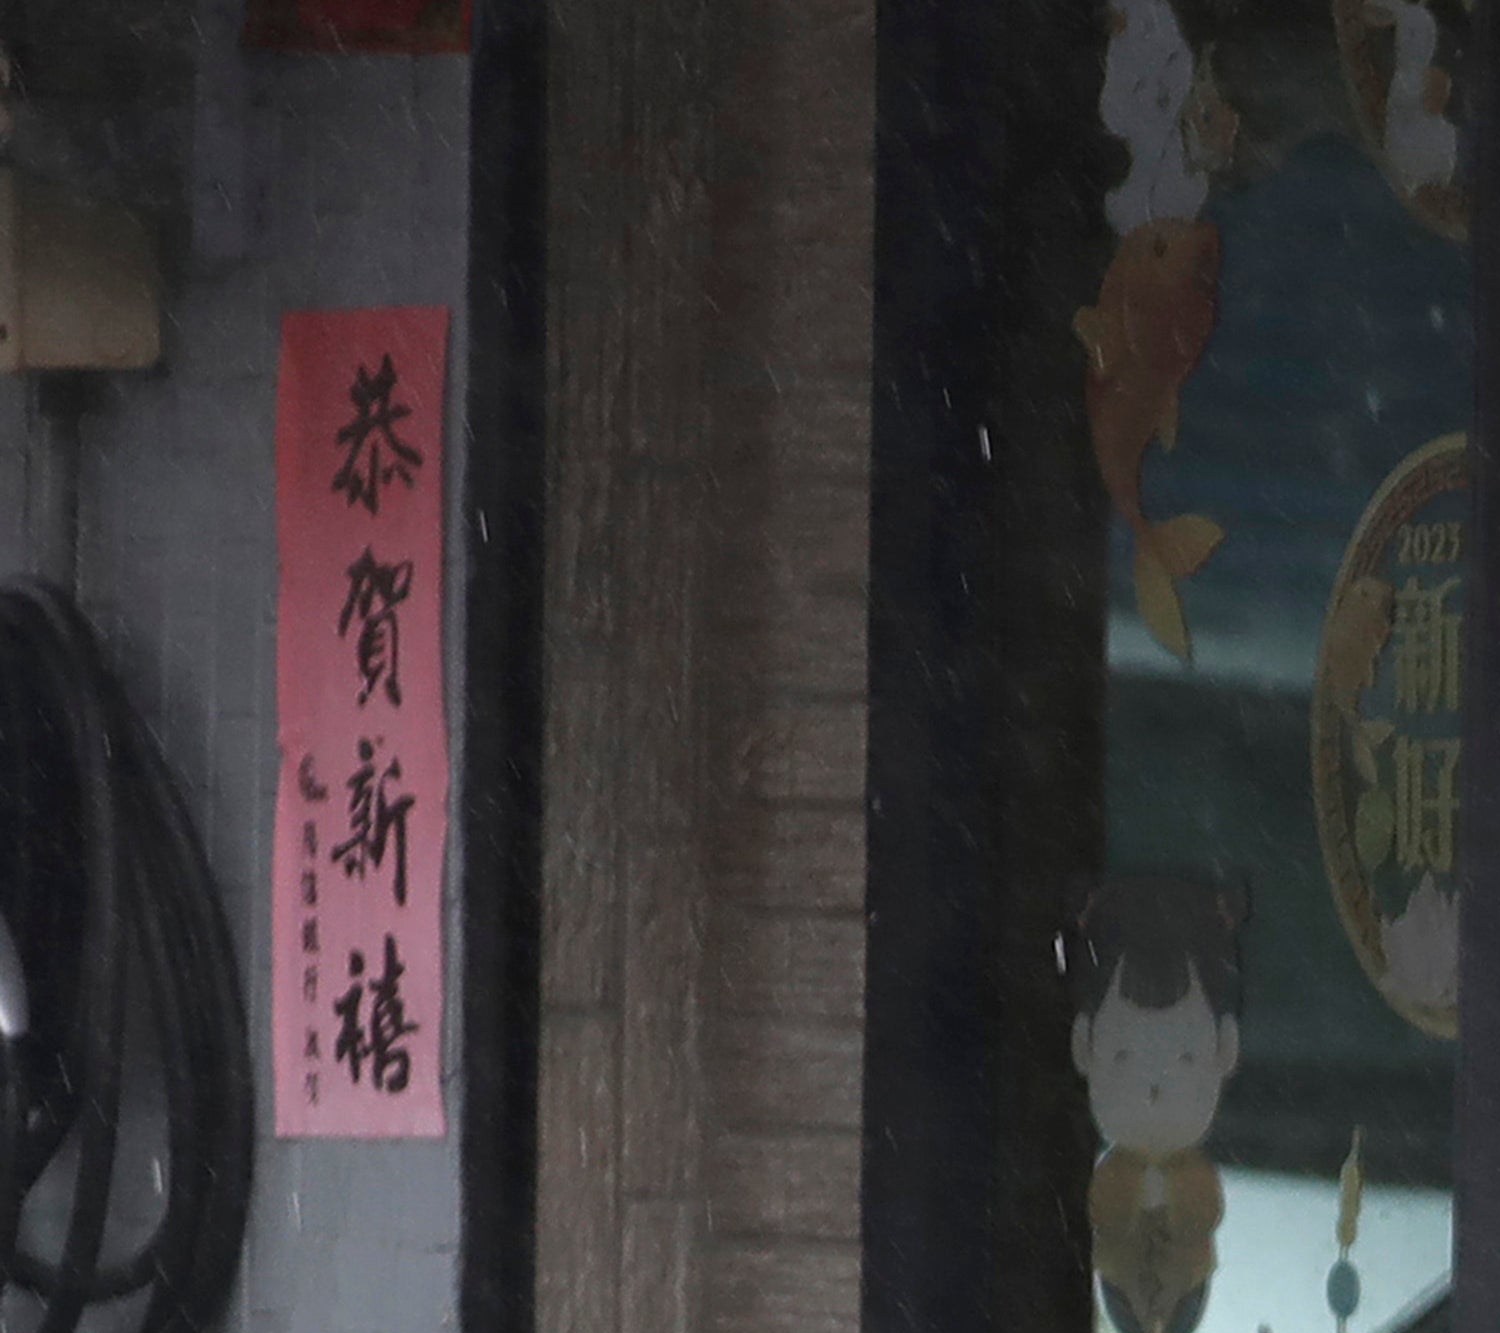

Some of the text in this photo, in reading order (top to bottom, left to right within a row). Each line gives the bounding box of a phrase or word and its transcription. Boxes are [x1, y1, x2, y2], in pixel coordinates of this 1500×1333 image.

[331, 354, 423, 1096] 恭賀新禧
[1398, 523, 1464, 566] 2023
